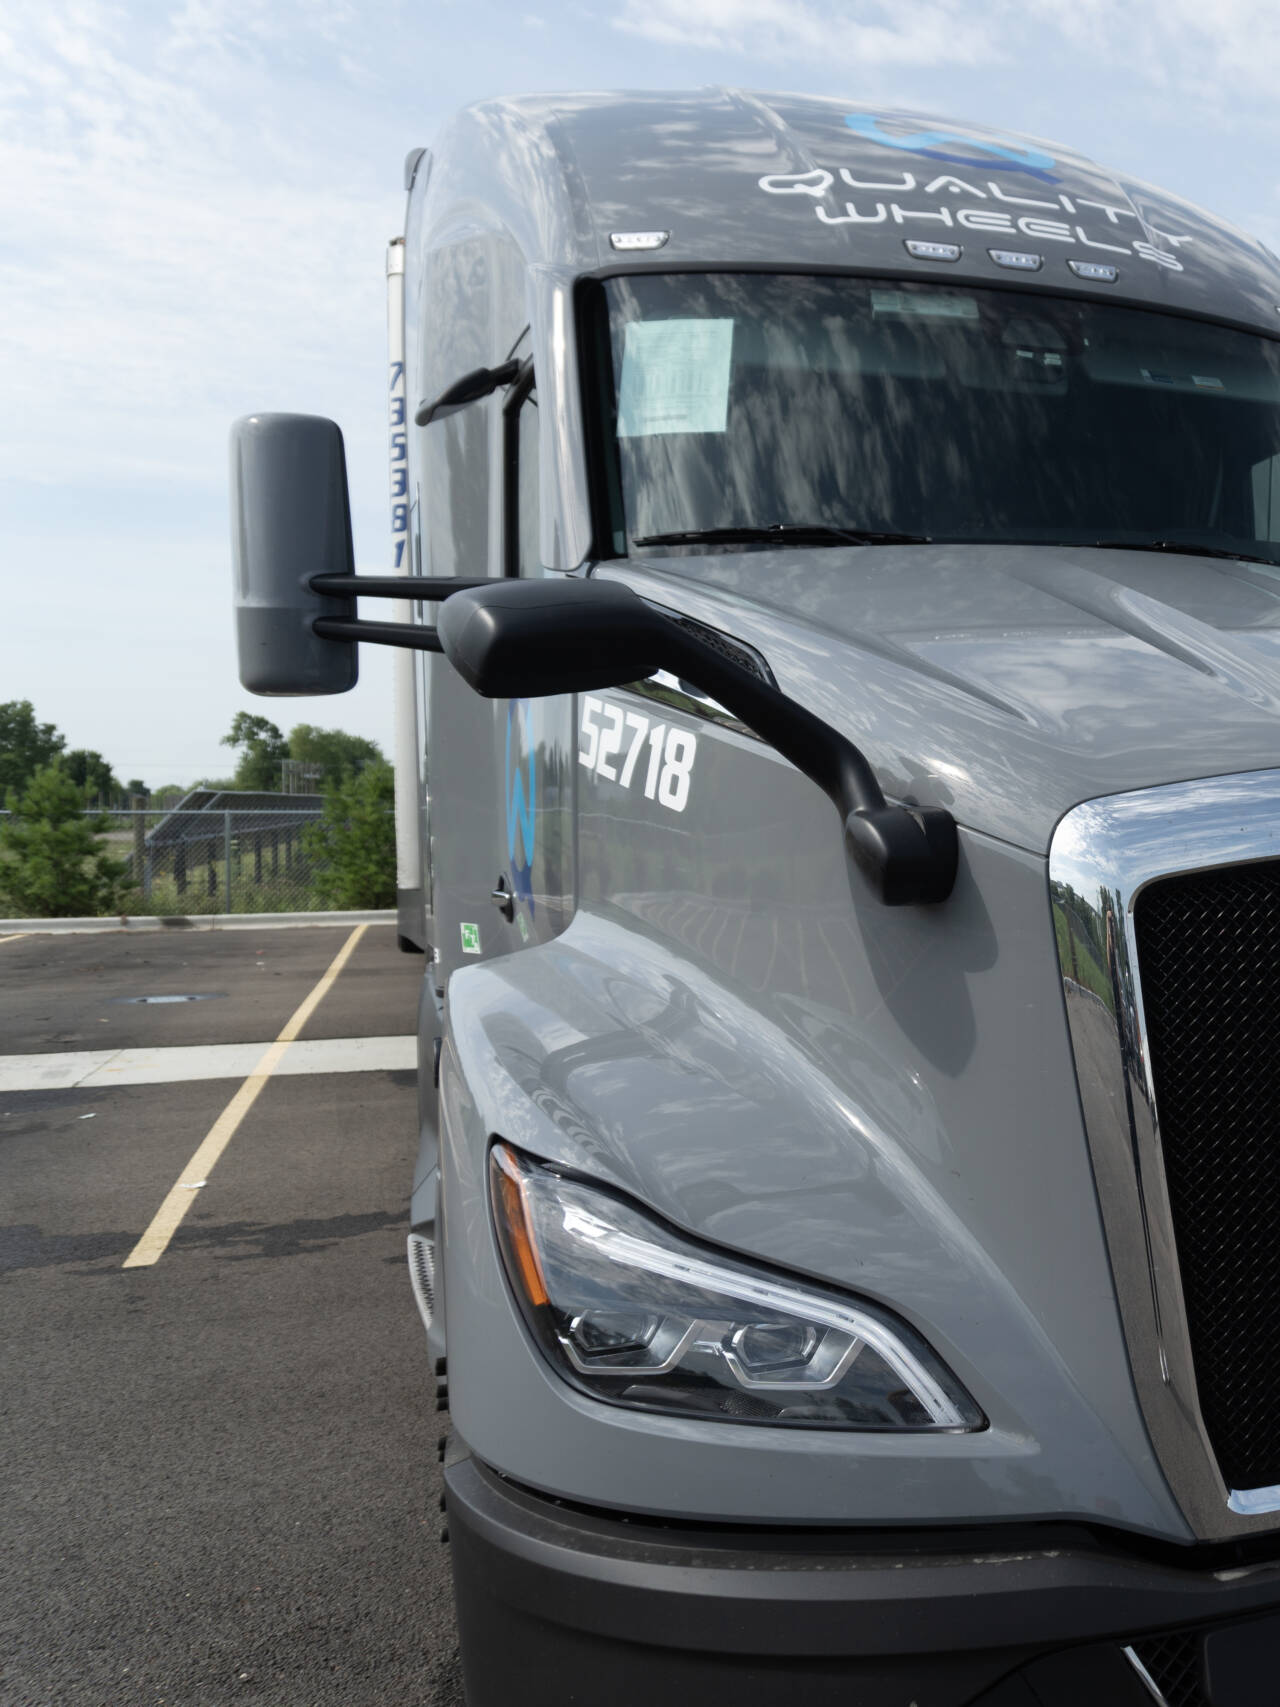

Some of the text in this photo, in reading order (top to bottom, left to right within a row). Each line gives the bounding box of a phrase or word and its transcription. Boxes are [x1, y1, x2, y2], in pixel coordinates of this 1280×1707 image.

[758, 167, 1193, 247] QUALITY
[816, 201, 1184, 271] WHEELS
[390, 361, 408, 568] 735381
[578, 695, 697, 812] 52718
